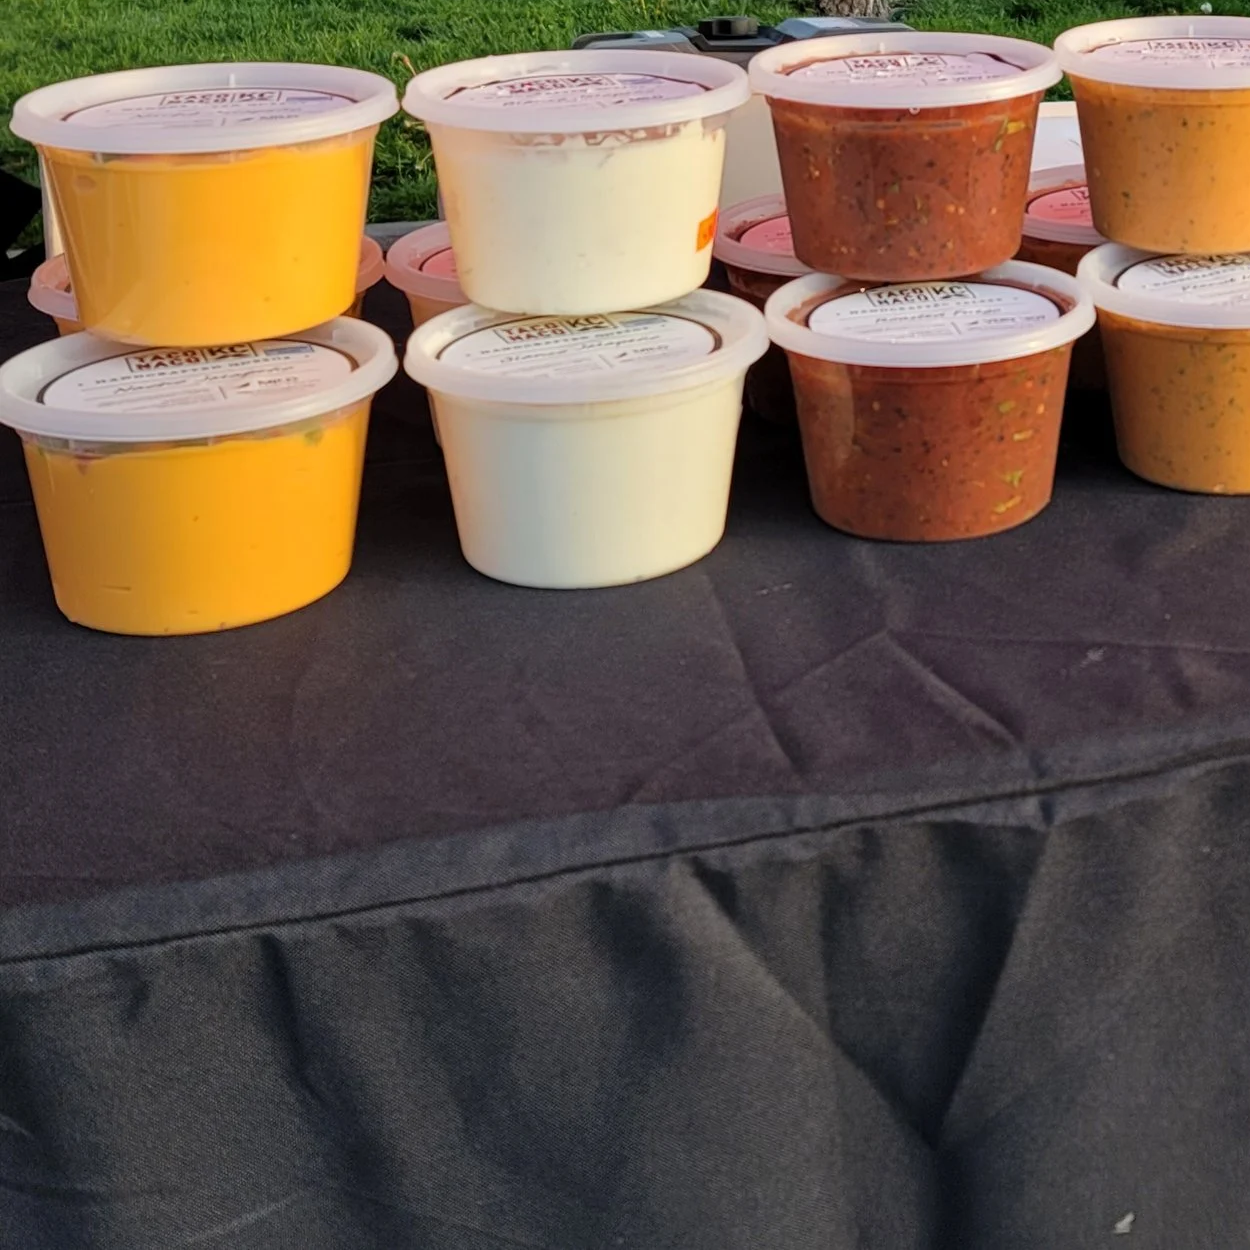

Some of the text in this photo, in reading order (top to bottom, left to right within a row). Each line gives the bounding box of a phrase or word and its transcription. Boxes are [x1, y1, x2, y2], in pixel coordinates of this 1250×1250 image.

[501, 322, 558, 336] TACO
[566, 316, 604, 328] KC
[507, 327, 566, 342] NACO
[135, 349, 198, 364] TACO
[208, 345, 248, 356] KC
[136, 357, 201, 371] NACO
